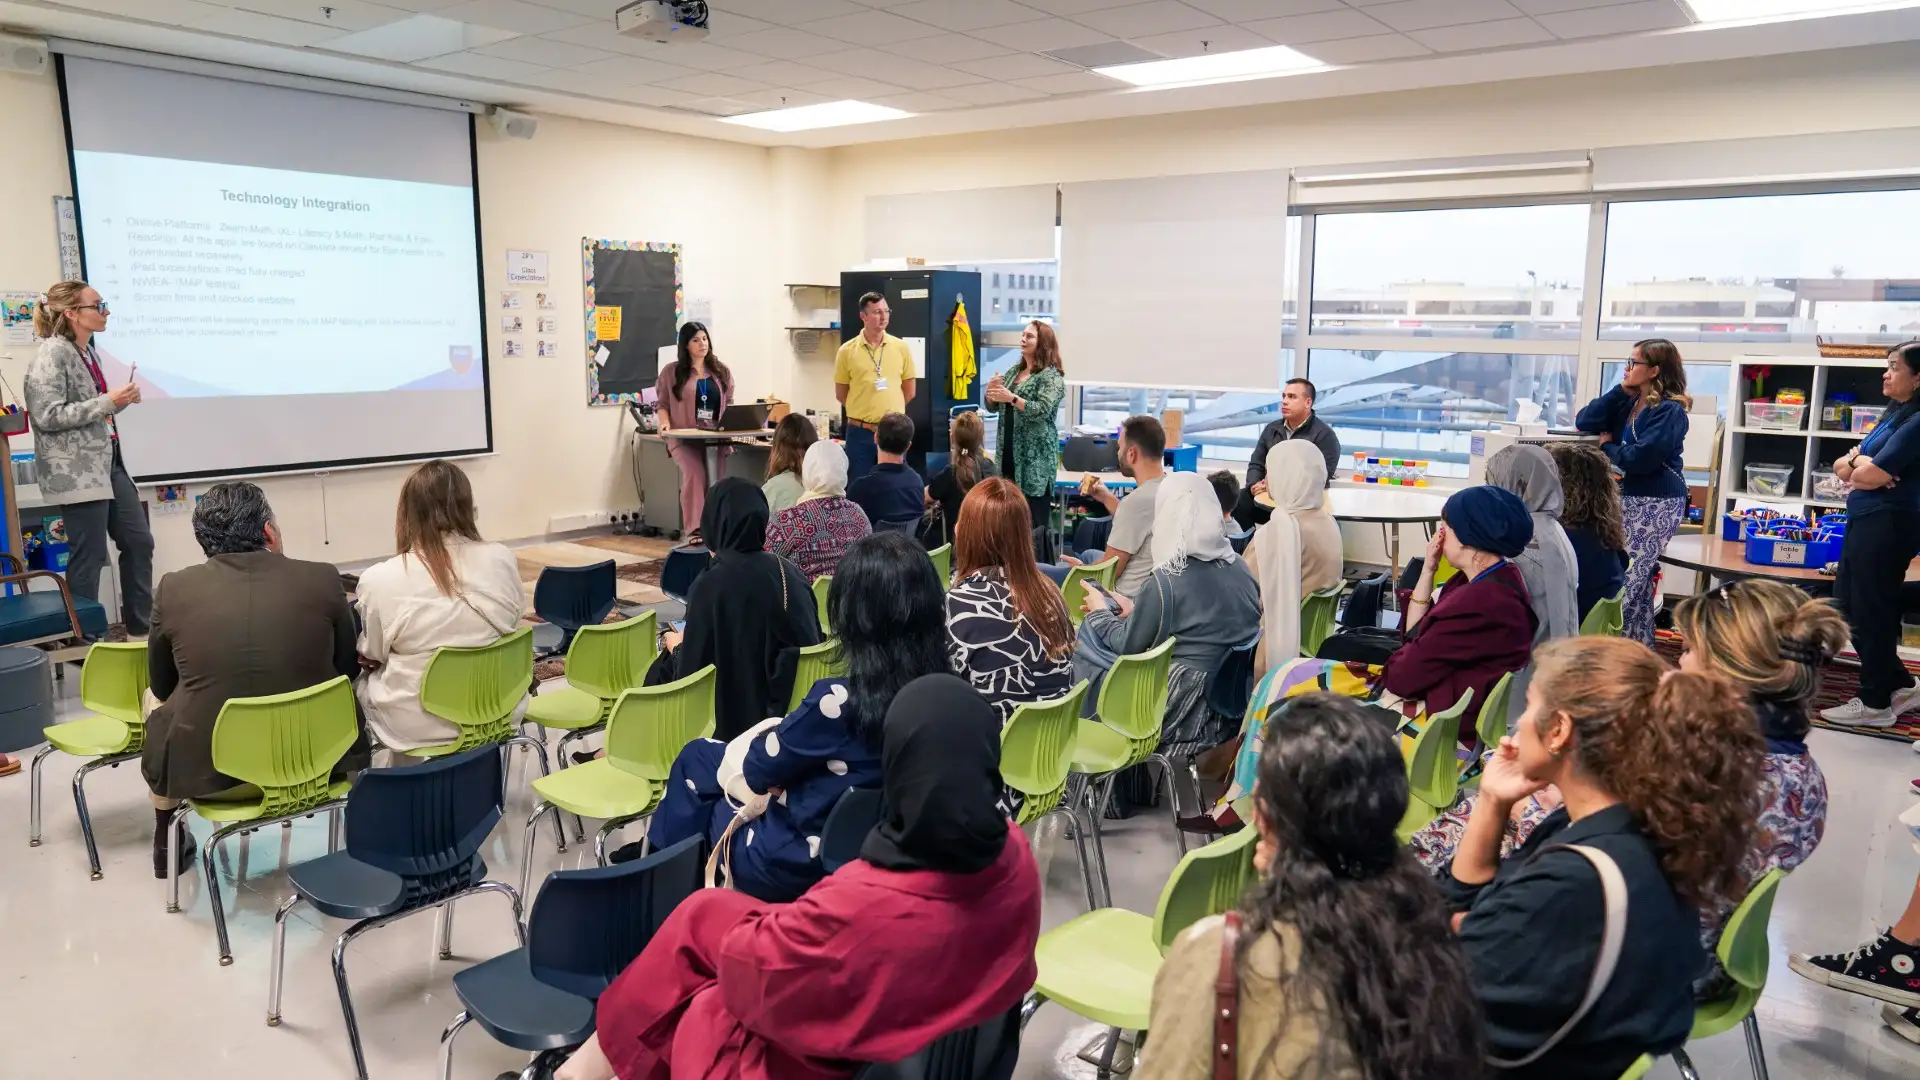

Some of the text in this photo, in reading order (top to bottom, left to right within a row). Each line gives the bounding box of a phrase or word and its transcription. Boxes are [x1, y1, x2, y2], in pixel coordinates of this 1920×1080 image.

[220, 189, 371, 212] Technology Integration
[125, 216, 162, 228] Online
[132, 292, 172, 304] Screen
[1780, 545, 1799, 553] Table
